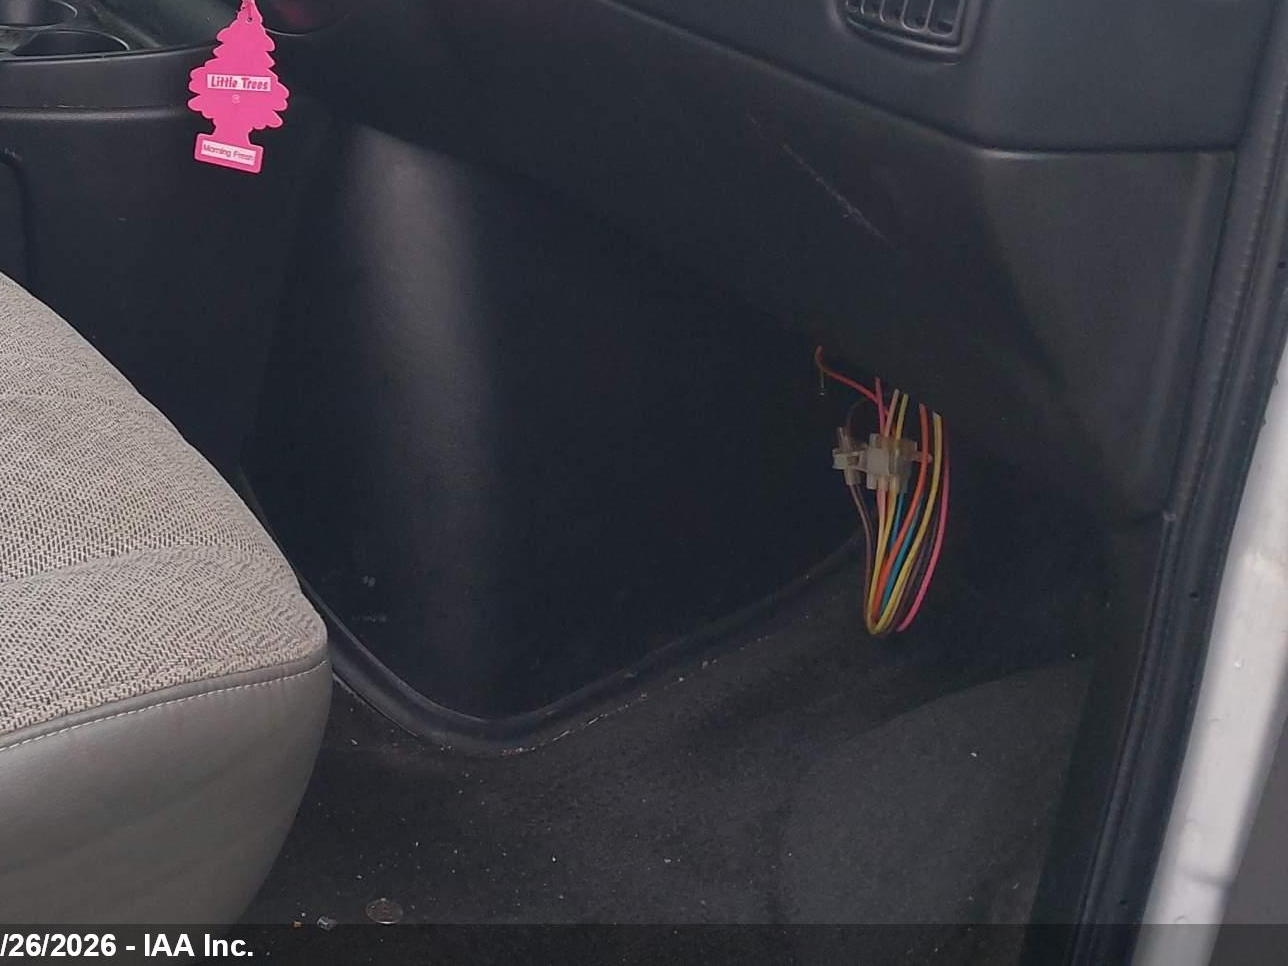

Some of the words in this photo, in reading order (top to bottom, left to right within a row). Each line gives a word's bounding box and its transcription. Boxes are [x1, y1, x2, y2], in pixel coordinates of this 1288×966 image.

[211, 76, 238, 88] Little
[242, 77, 269, 90] Trees
[203, 144, 232, 157] Morning
[233, 150, 254, 162] Fresh
